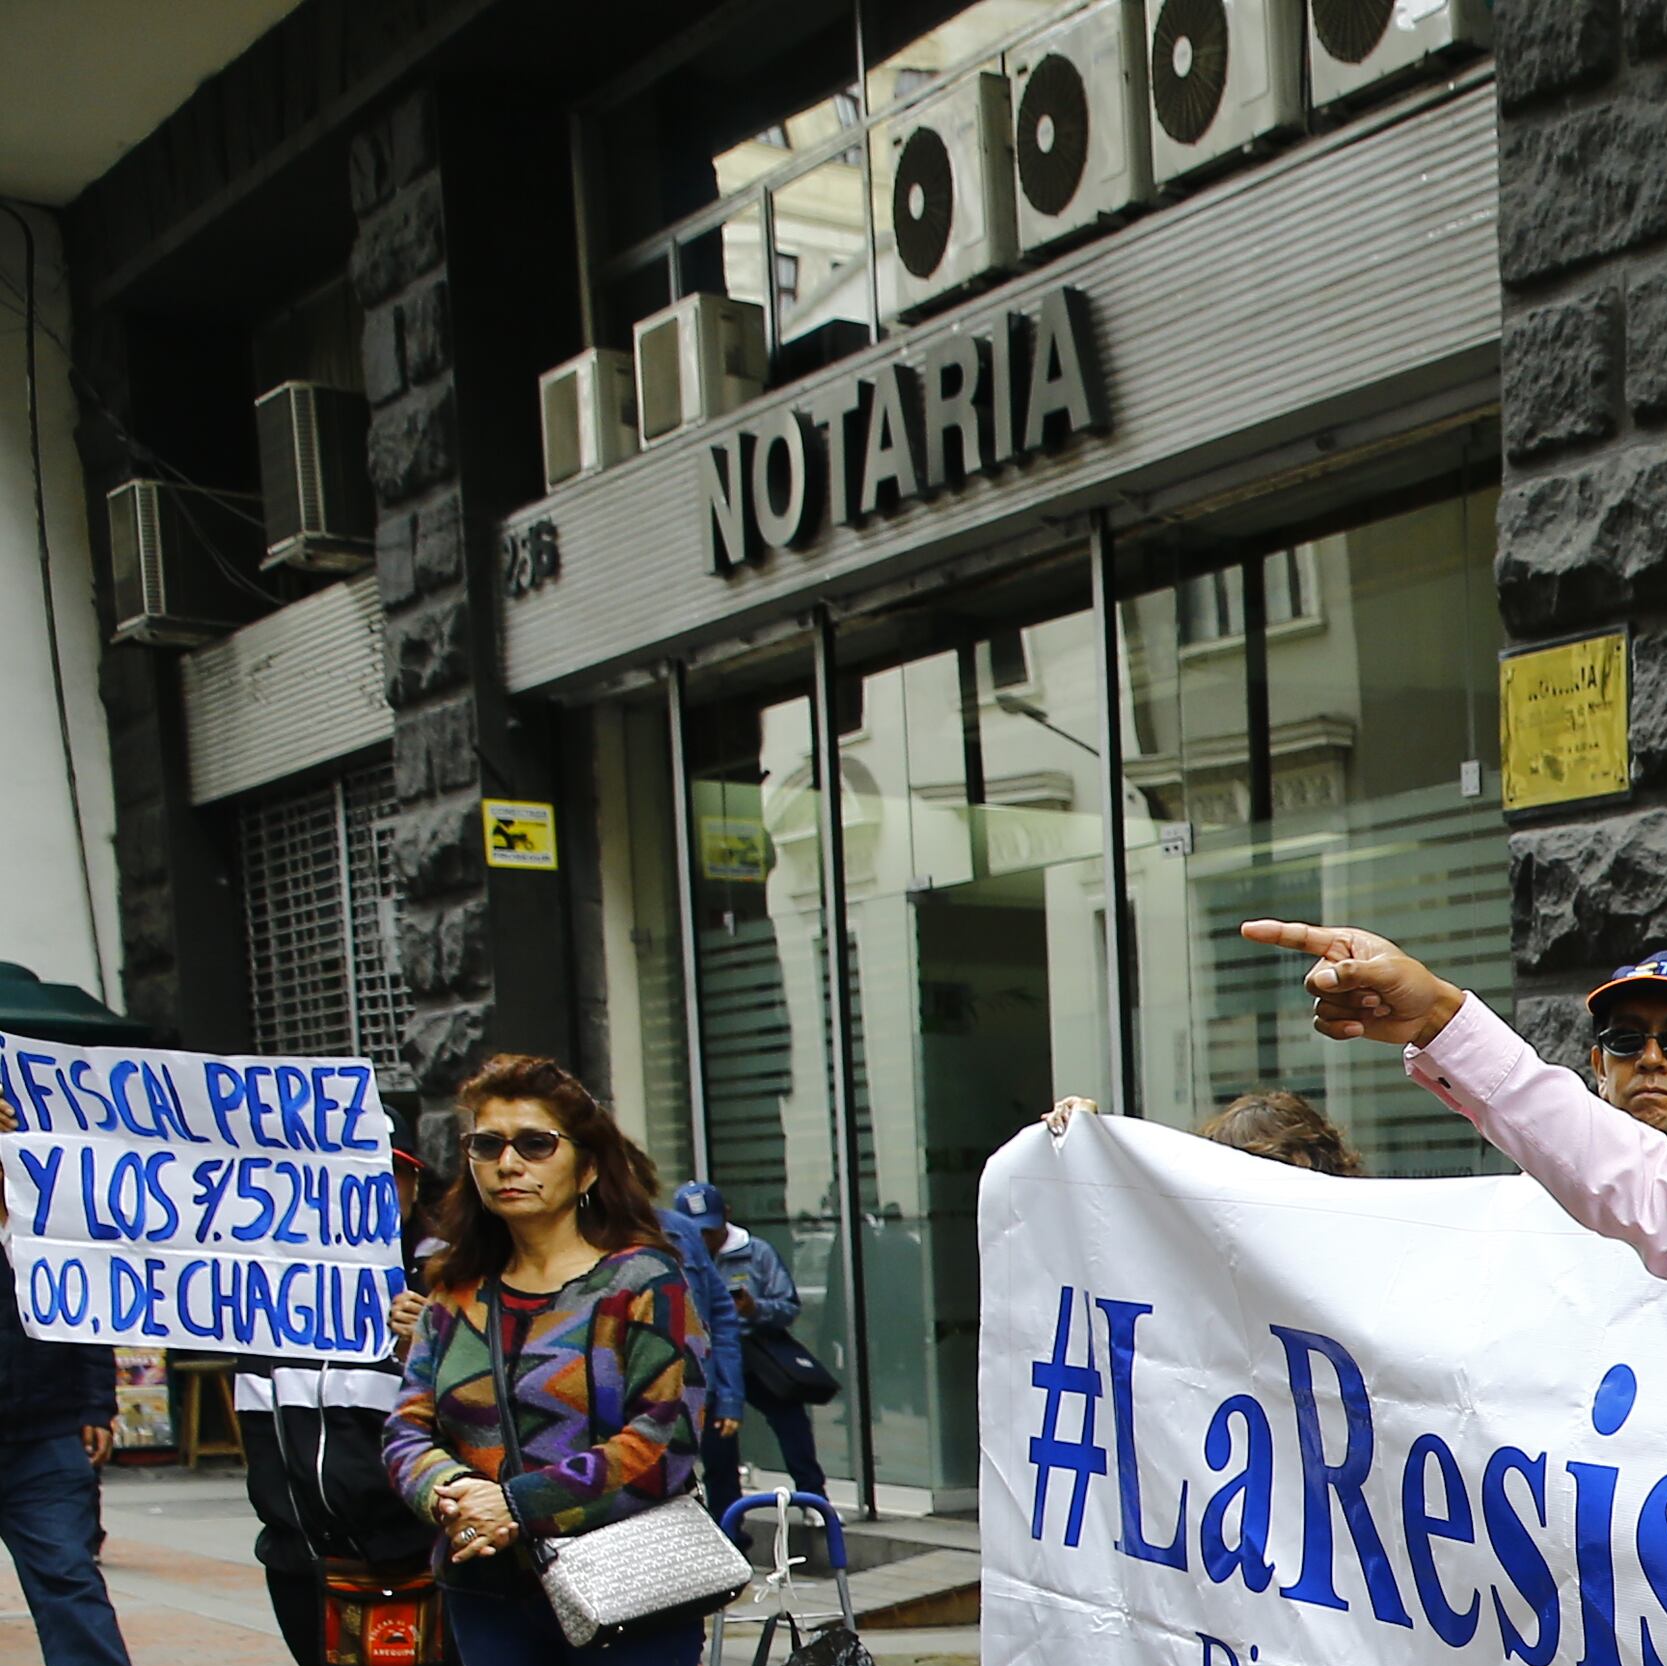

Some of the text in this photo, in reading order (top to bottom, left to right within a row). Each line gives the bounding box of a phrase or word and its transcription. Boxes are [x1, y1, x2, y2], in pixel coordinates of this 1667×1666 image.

[701, 285, 1096, 575] NOTARIA
[205, 1062, 379, 1152] PEREZ
[19, 1146, 63, 1237] Y
[81, 1146, 180, 1242] LOS
[110, 1256, 169, 1337] DE
